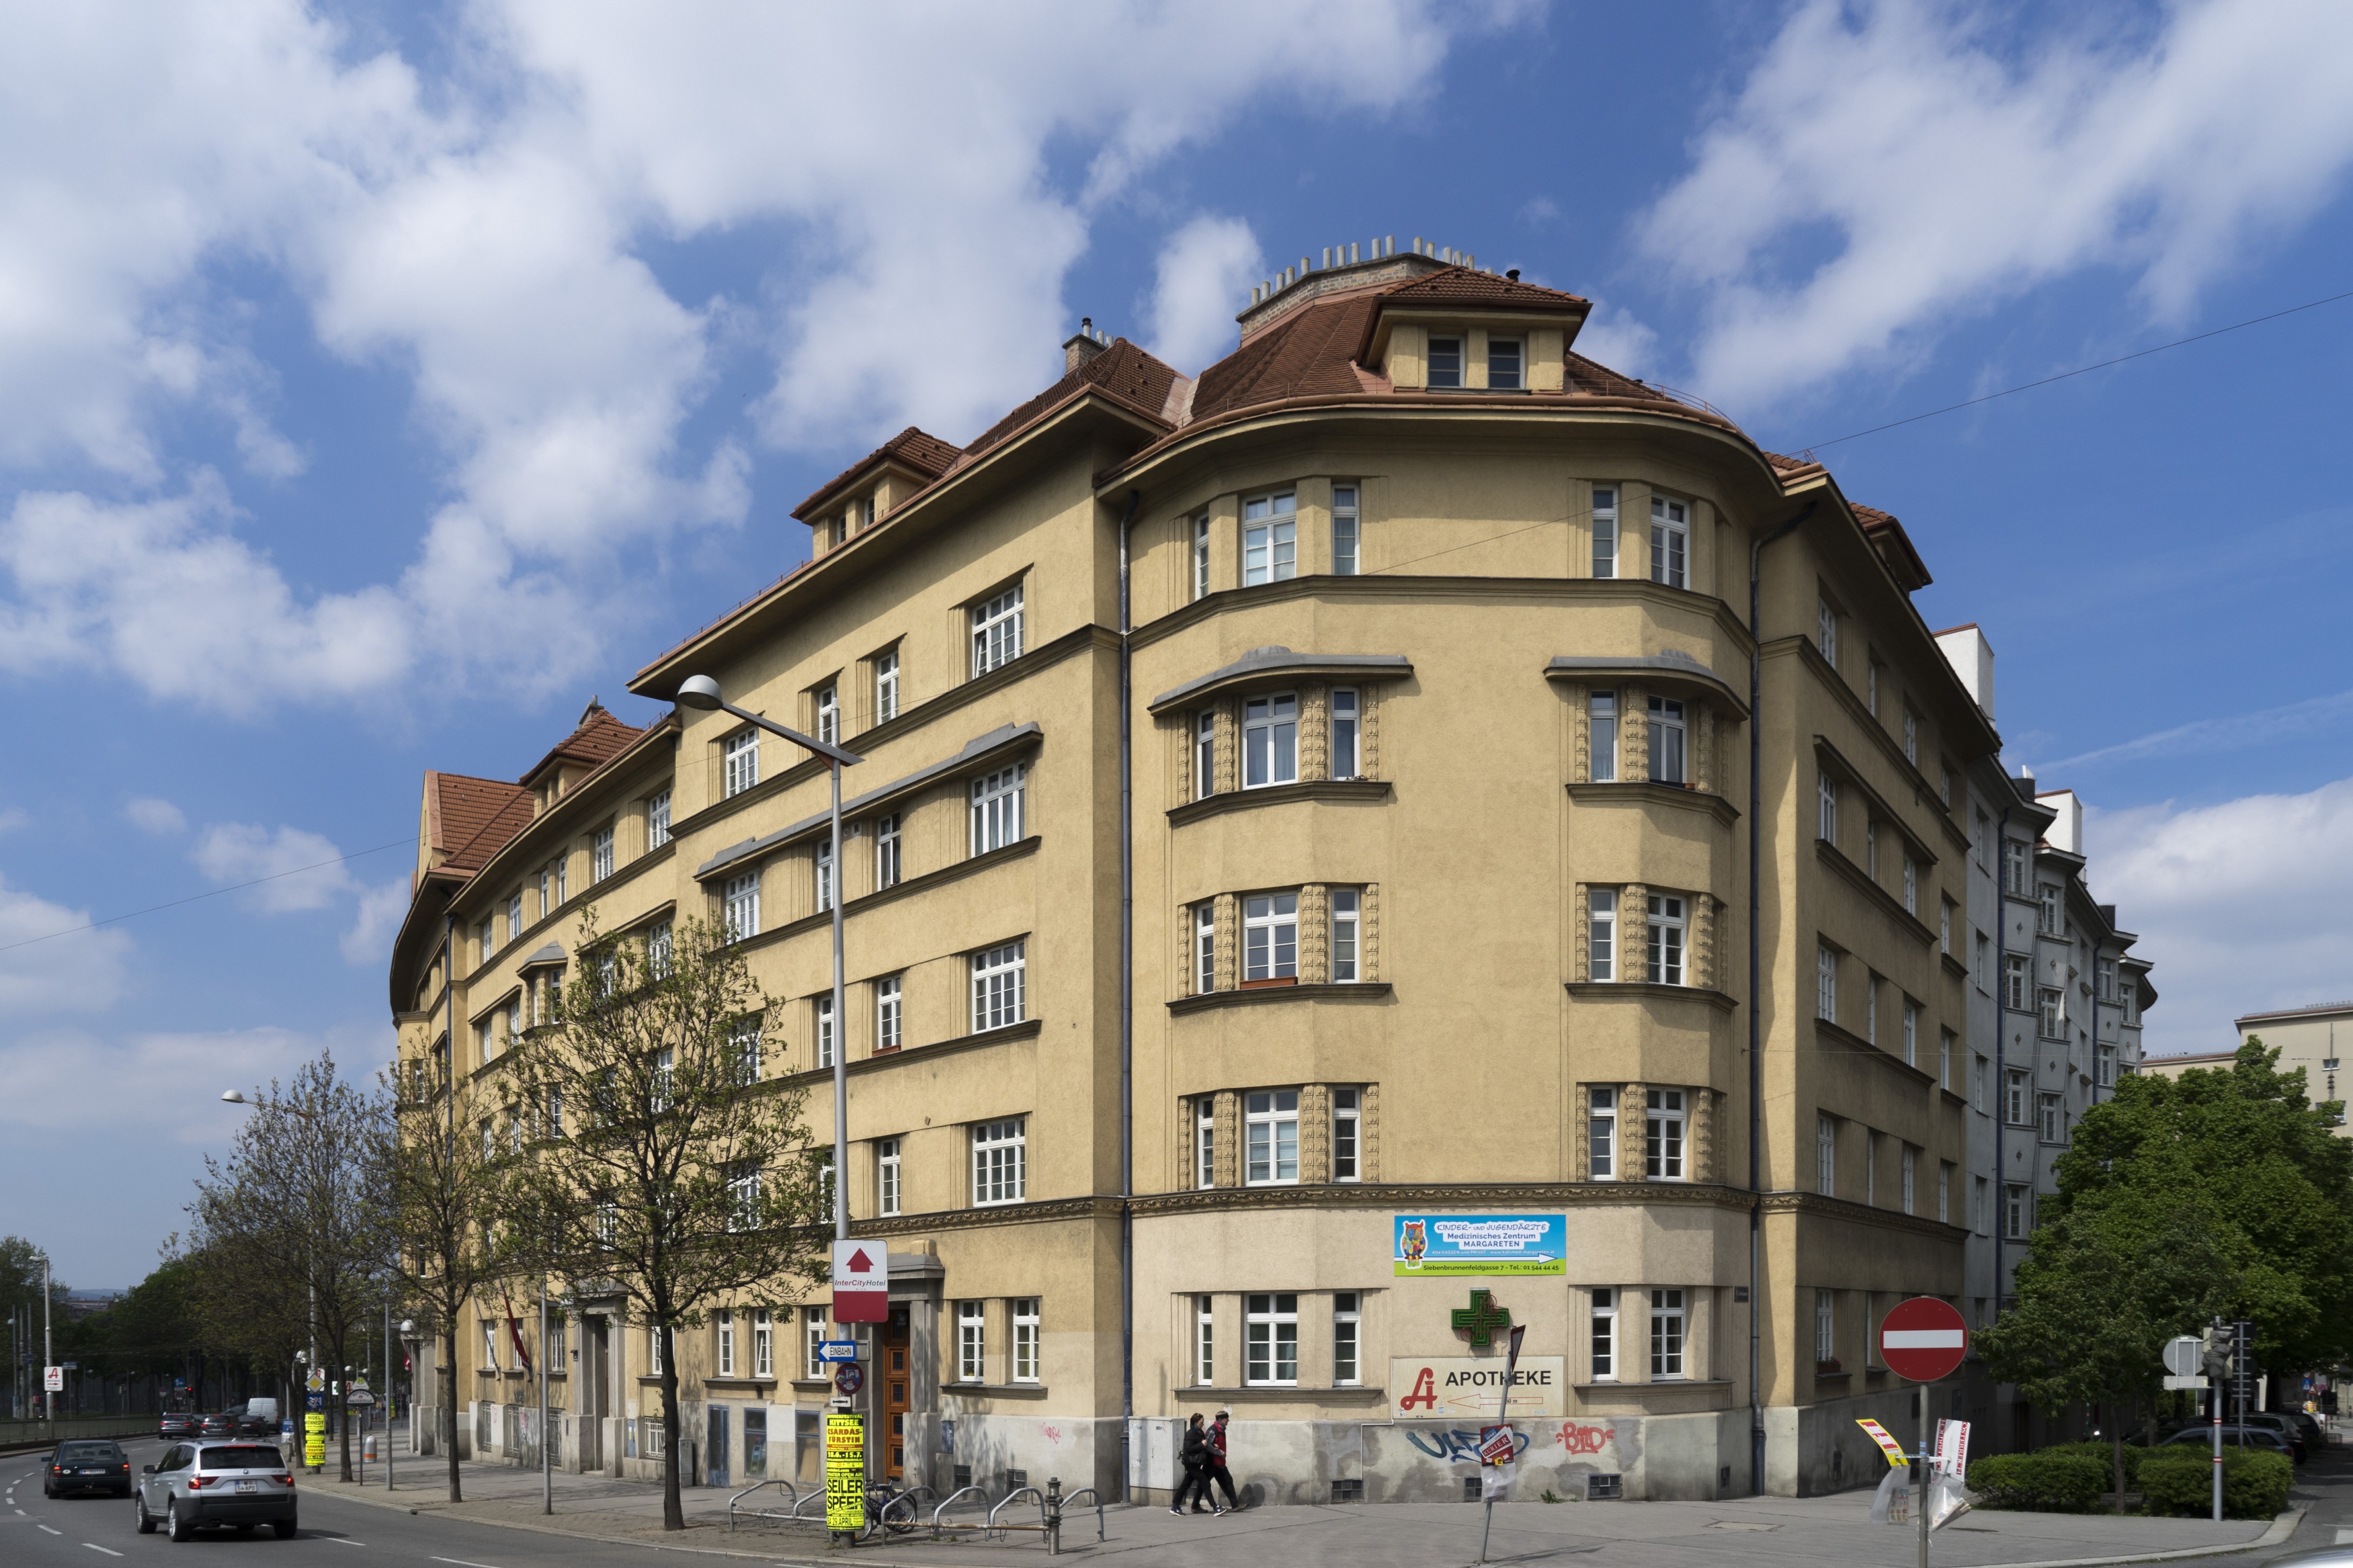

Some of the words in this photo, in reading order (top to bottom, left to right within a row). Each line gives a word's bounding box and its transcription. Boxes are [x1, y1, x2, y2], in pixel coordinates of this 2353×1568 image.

[830, 1346, 852, 1356] EINBAHN
[1486, 1431, 1497, 1440] SPORT
[1483, 1437, 1509, 1456] KURIER
[828, 1479, 863, 1493] SEILER
[828, 1496, 863, 1510] SPEER
[827, 1517, 831, 1525] SA
